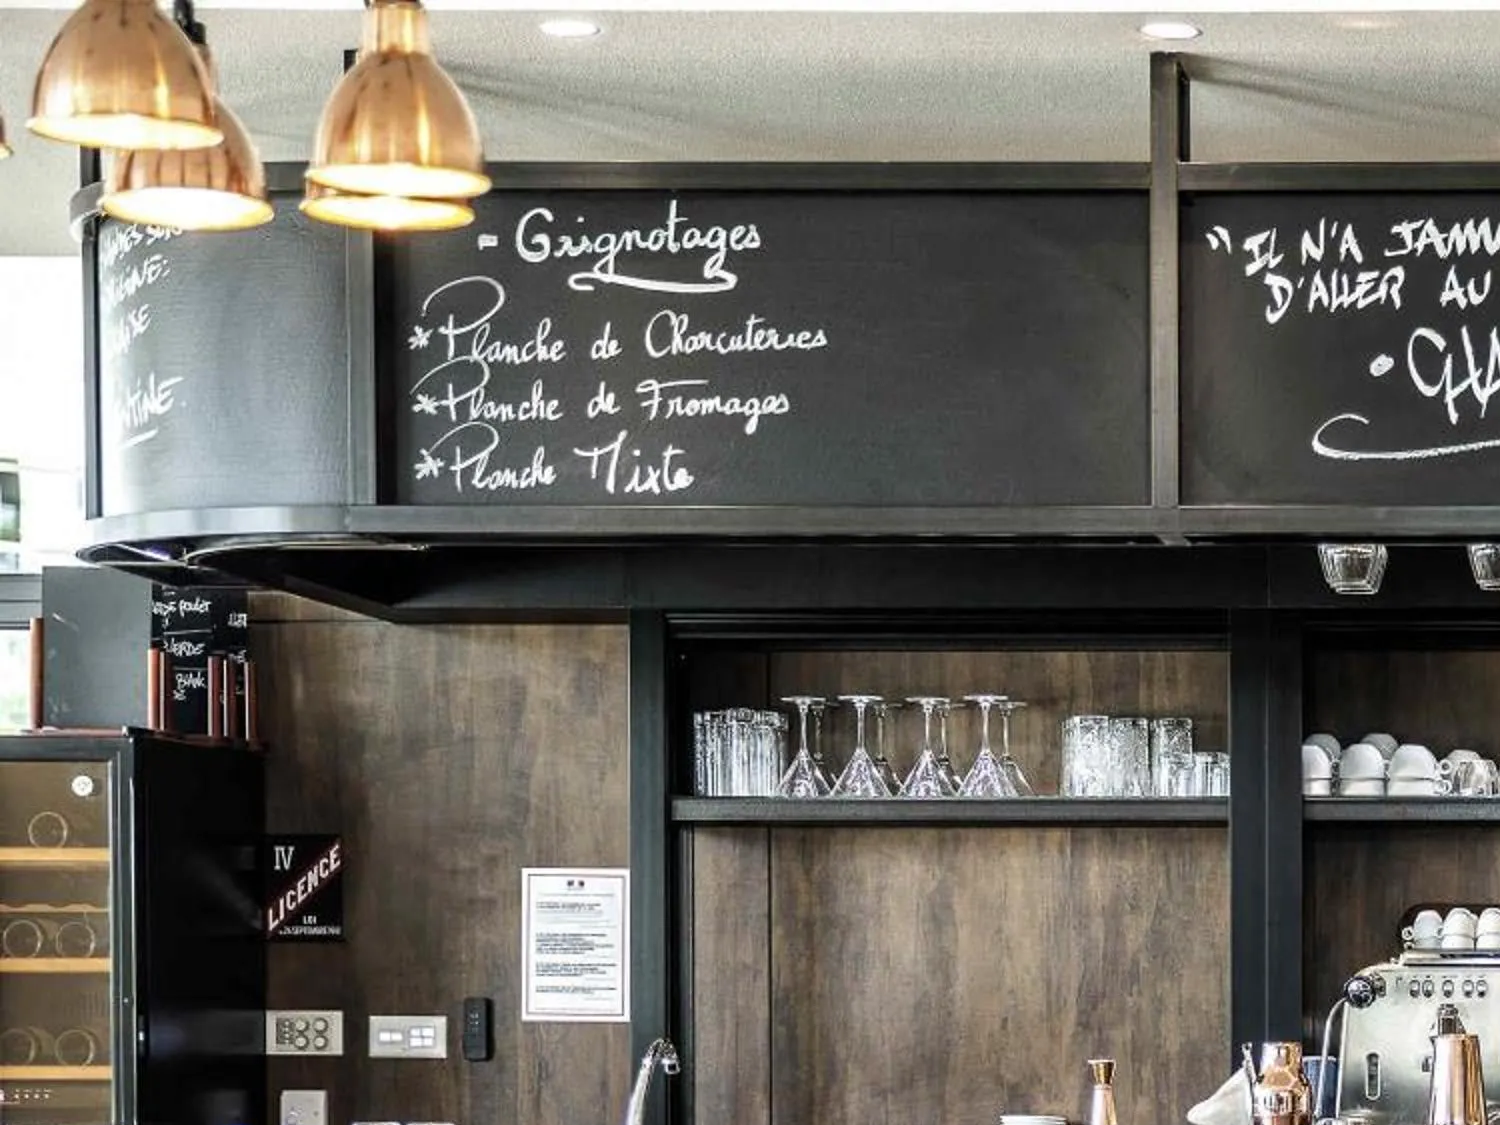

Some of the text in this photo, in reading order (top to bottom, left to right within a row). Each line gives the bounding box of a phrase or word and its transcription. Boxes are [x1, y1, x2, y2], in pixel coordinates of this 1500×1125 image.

[515, 200, 761, 280] Grignotages
[1301, 217, 1363, 266] N'A
[422, 276, 566, 365] Planche
[590, 321, 622, 359] de
[1264, 265, 1491, 324] D'ALLER AU
[412, 355, 563, 422] Planche
[585, 381, 621, 418] de
[428, 421, 557, 493] Planche
[269, 844, 341, 932] LICENCE
[274, 846, 295, 870] IV
